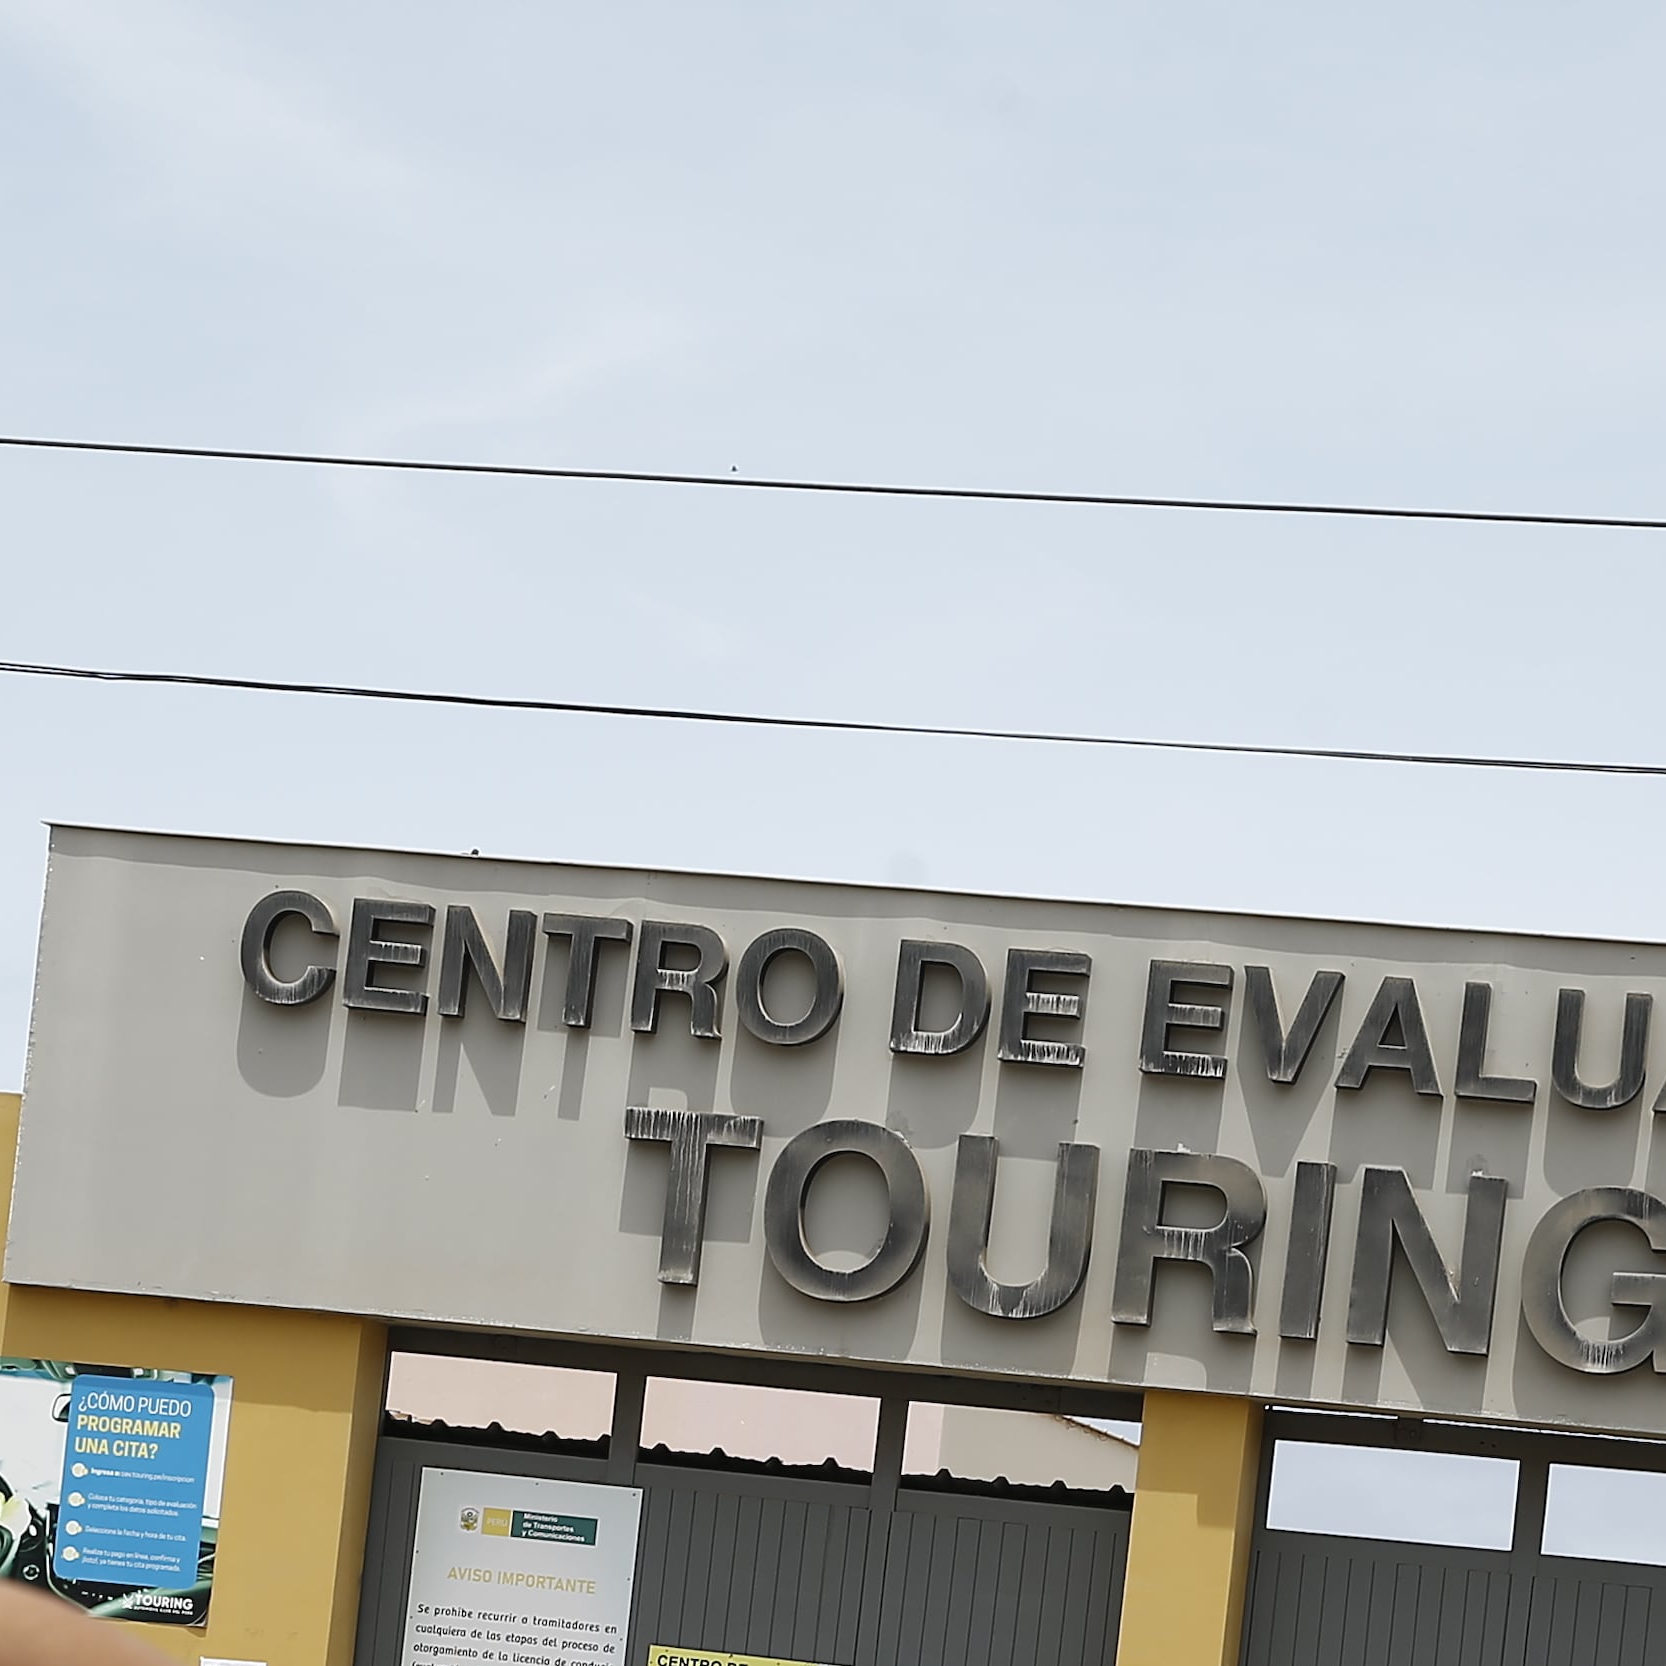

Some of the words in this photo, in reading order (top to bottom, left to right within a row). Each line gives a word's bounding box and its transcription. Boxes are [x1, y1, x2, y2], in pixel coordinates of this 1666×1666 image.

[240, 890, 844, 1046] CENTRO
[889, 938, 1092, 1069] DE
[77, 1390, 135, 1412] ¿CÓMO
[137, 1396, 192, 1417] PUEDO
[76, 1414, 181, 1439] PROGRAMAR
[74, 1436, 109, 1455] UNA
[112, 1440, 159, 1459] CITA?
[522, 1513, 558, 1523] Ministerio
[522, 1521, 532, 1529] de
[532, 1521, 575, 1534] Transportes
[527, 1529, 586, 1542] Comunicaciones
[446, 1566, 493, 1583] AVISO
[496, 1570, 596, 1595] IMPORTANTE
[135, 1592, 194, 1610] TOURING
[417, 1603, 430, 1614] Se
[477, 1611, 517, 1623] recurrir
[521, 1616, 528, 1624] a
[532, 1615, 600, 1632] tramitadores
[604, 1625, 617, 1634] en
[415, 1624, 466, 1637] cualquiera
[470, 1628, 483, 1639] de
[486, 1629, 501, 1641] las
[505, 1632, 538, 1646] etapas
[541, 1636, 557, 1647] del
[561, 1640, 599, 1652] proceso
[602, 1643, 615, 1654] de
[413, 1642, 478, 1658] otorgamiento
[481, 1649, 494, 1660] de
[497, 1650, 508, 1661] la
[512, 1652, 550, 1666] licencia
